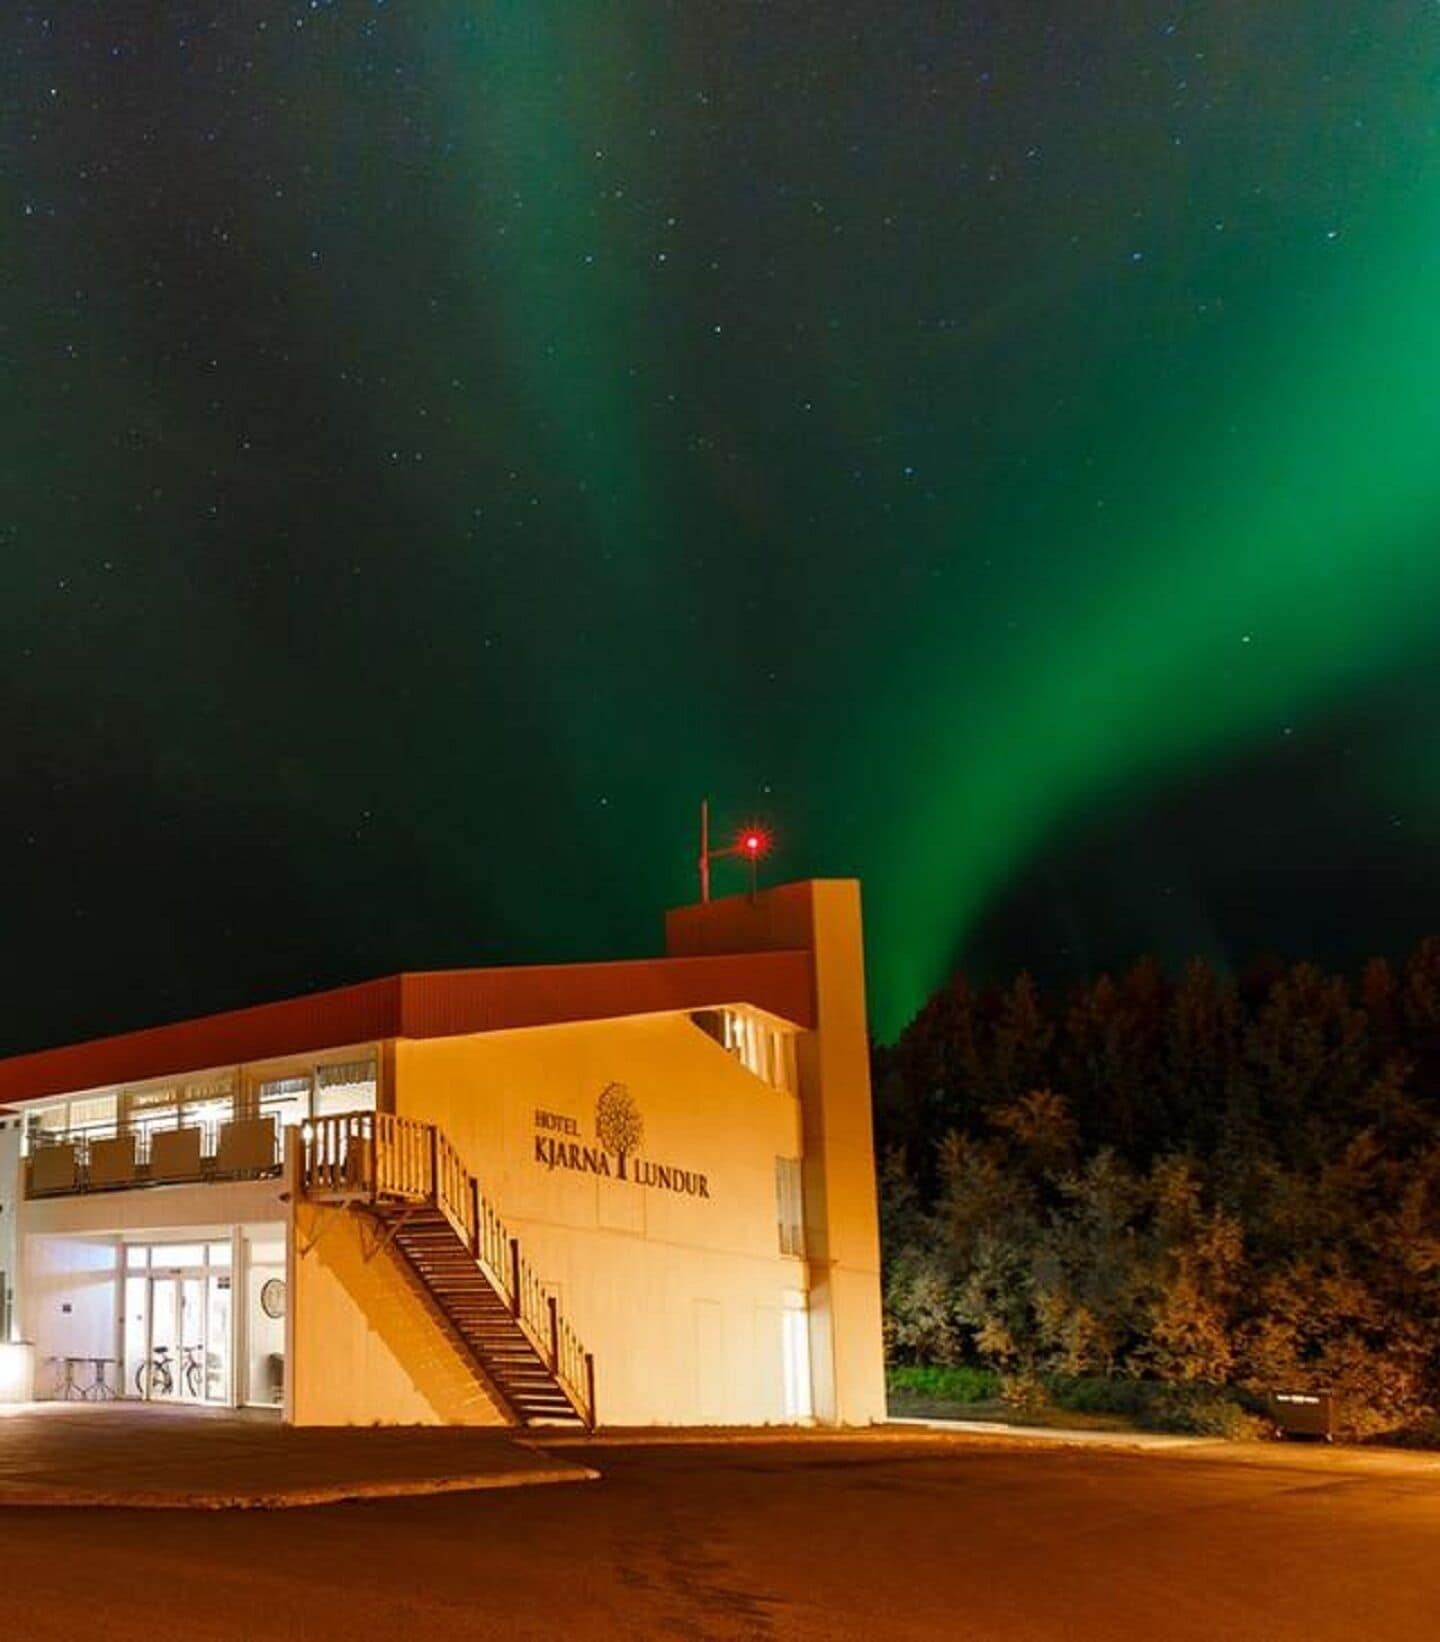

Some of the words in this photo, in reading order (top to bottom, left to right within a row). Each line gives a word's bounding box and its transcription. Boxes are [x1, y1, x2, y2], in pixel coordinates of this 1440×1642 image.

[534, 1109, 579, 1135] HOTEL
[535, 1135, 610, 1176] KJARNA
[634, 1158, 710, 1199] LUNDUR
